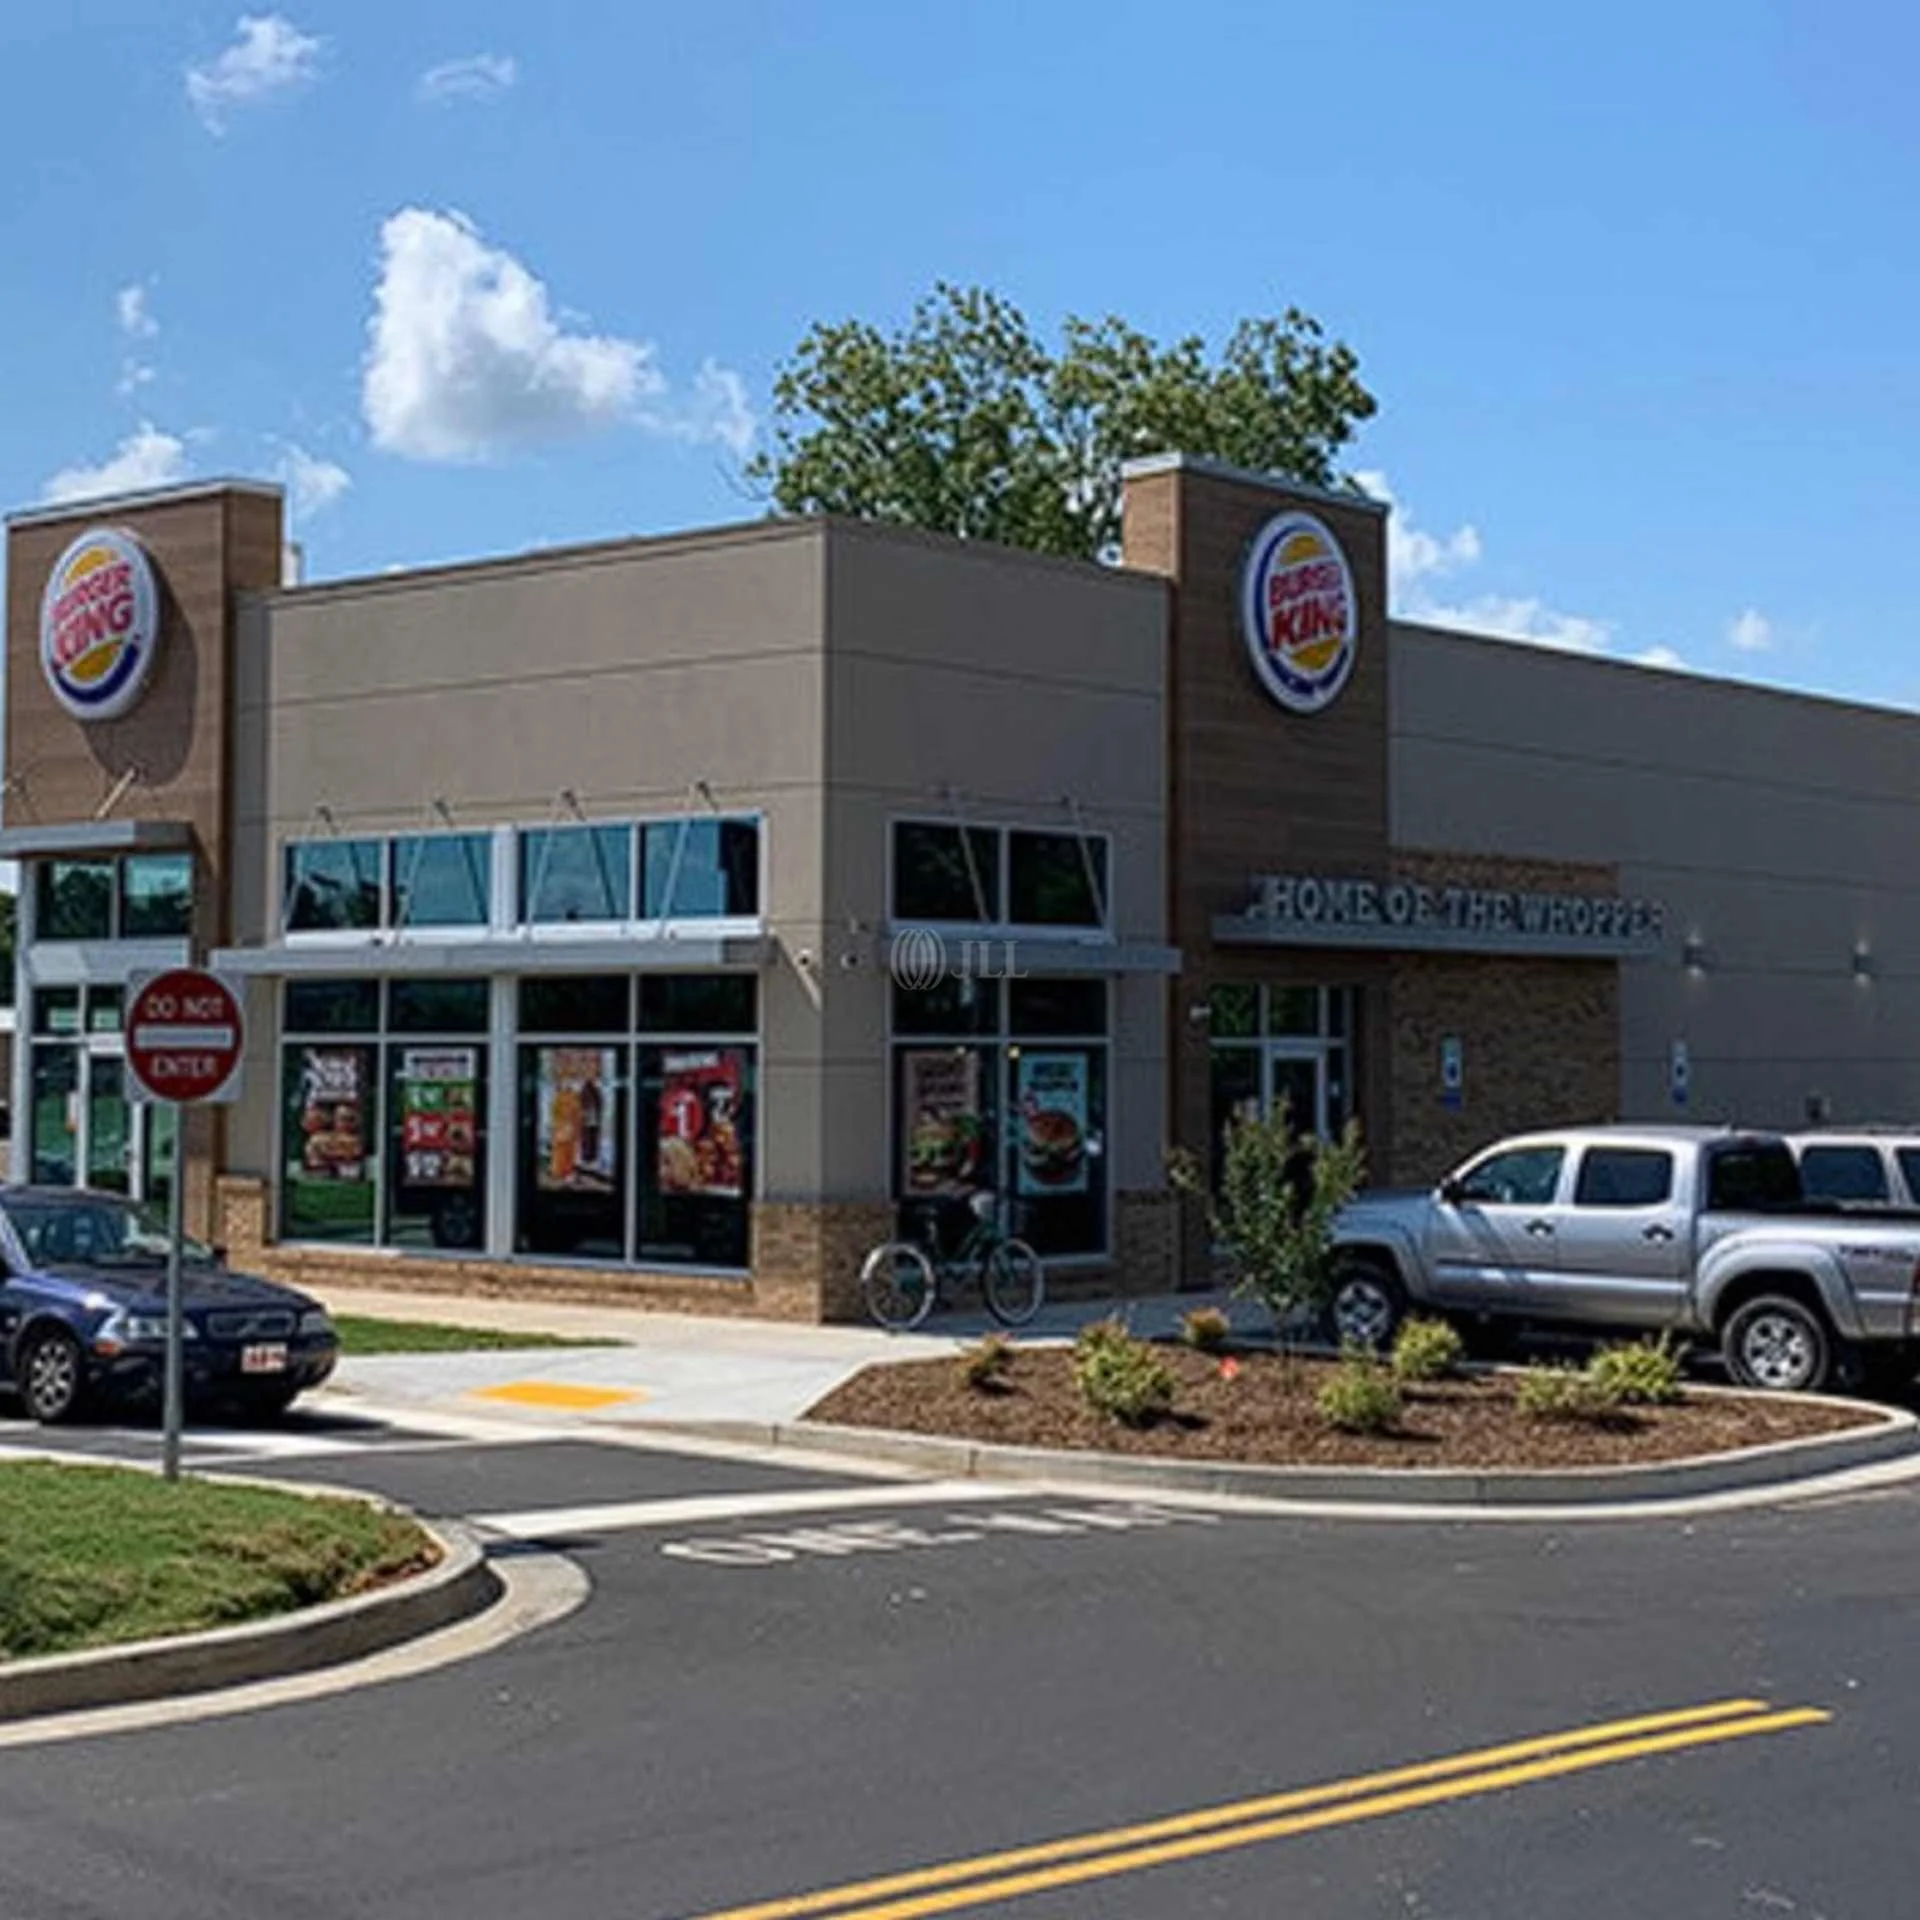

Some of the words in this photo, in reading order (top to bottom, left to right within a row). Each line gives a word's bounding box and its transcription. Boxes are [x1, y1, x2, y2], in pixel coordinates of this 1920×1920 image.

[54, 592, 135, 663] KING
[1271, 590, 1347, 651] KING
[1269, 877, 1378, 921] HOME
[1386, 885, 1434, 926] OF
[1444, 888, 1512, 934] THE
[1519, 893, 1666, 941] WHOPPER
[147, 995, 174, 1019] DO
[183, 996, 223, 1019] NOT
[151, 1055, 217, 1078] ENTER
